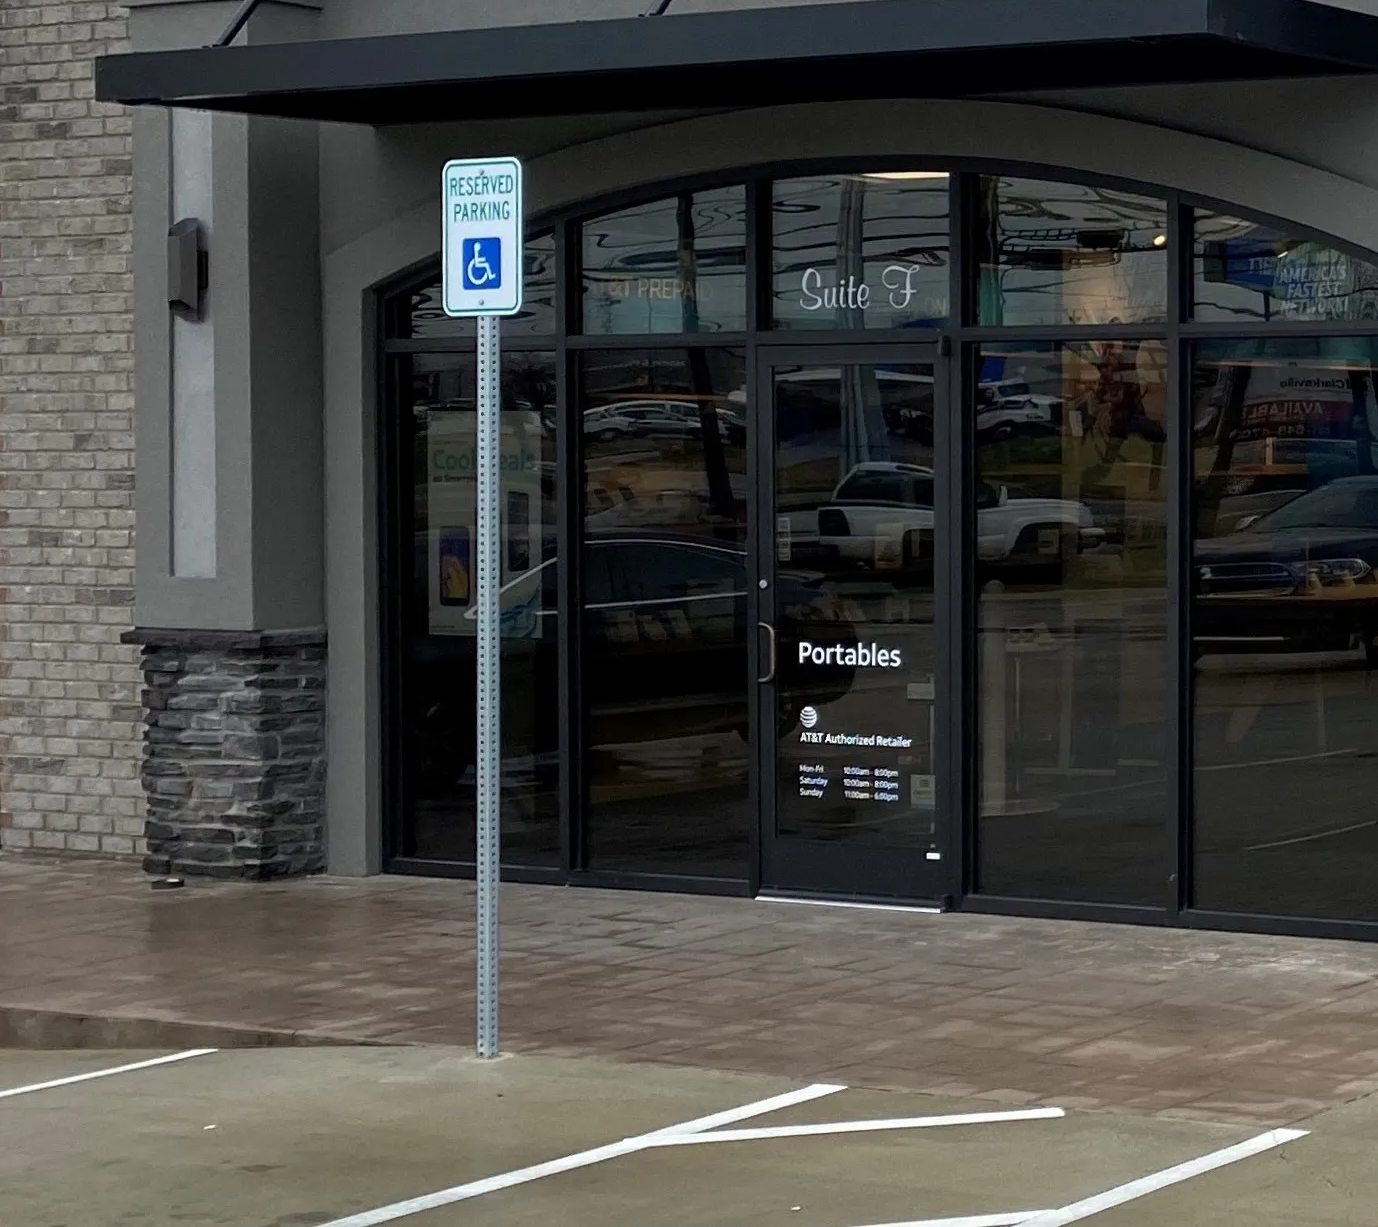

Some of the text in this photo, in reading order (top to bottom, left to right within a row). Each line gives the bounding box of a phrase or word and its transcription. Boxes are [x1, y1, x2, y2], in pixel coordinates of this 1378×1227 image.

[449, 174, 514, 197] RESERVED
[453, 200, 510, 222] PARKING
[800, 265, 919, 310] Suite F
[1286, 281, 1344, 299] FASTEST
[798, 641, 902, 668] Portables
[800, 732, 912, 748] AT&T Authorized Retailer
[799, 776, 828, 787] Saturday
[799, 787, 824, 799] Sunday
